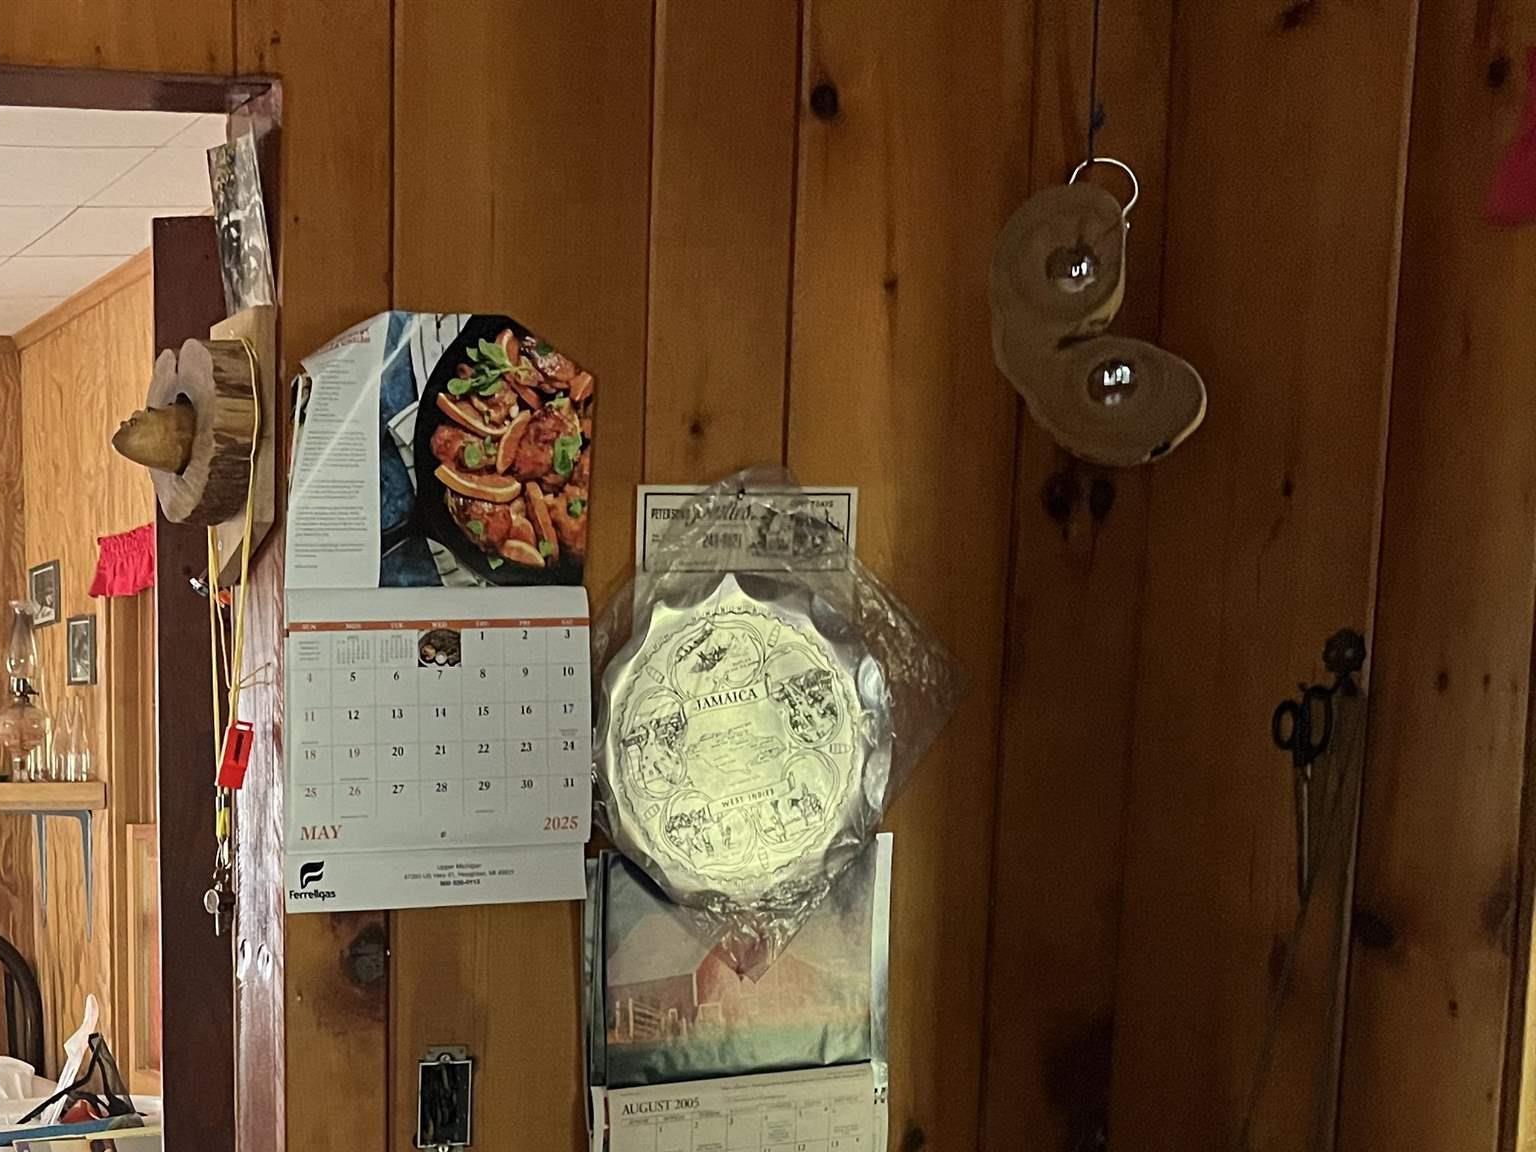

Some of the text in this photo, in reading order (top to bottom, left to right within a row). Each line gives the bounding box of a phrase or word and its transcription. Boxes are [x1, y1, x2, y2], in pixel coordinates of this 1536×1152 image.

[480, 629, 571, 641] 1 2 3
[350, 671, 357, 682] 5
[393, 670, 400, 681] 6
[437, 670, 443, 680] 7
[479, 669, 487, 679] 8
[522, 667, 529, 678] 9
[563, 665, 575, 677] 10
[696, 688, 758, 711] JAMAICA
[304, 703, 575, 722] 11 12 13 14 15 16 17
[304, 740, 576, 761] 18 19 20 21 22 23 24
[304, 777, 575, 799] 25 26 27 28 29 30 31
[300, 816, 579, 841] MAY 2025
[289, 889, 337, 902] Ferrellgas
[622, 1097, 701, 1116] AUGUST 2005
[797, 1143, 807, 1152] 12
